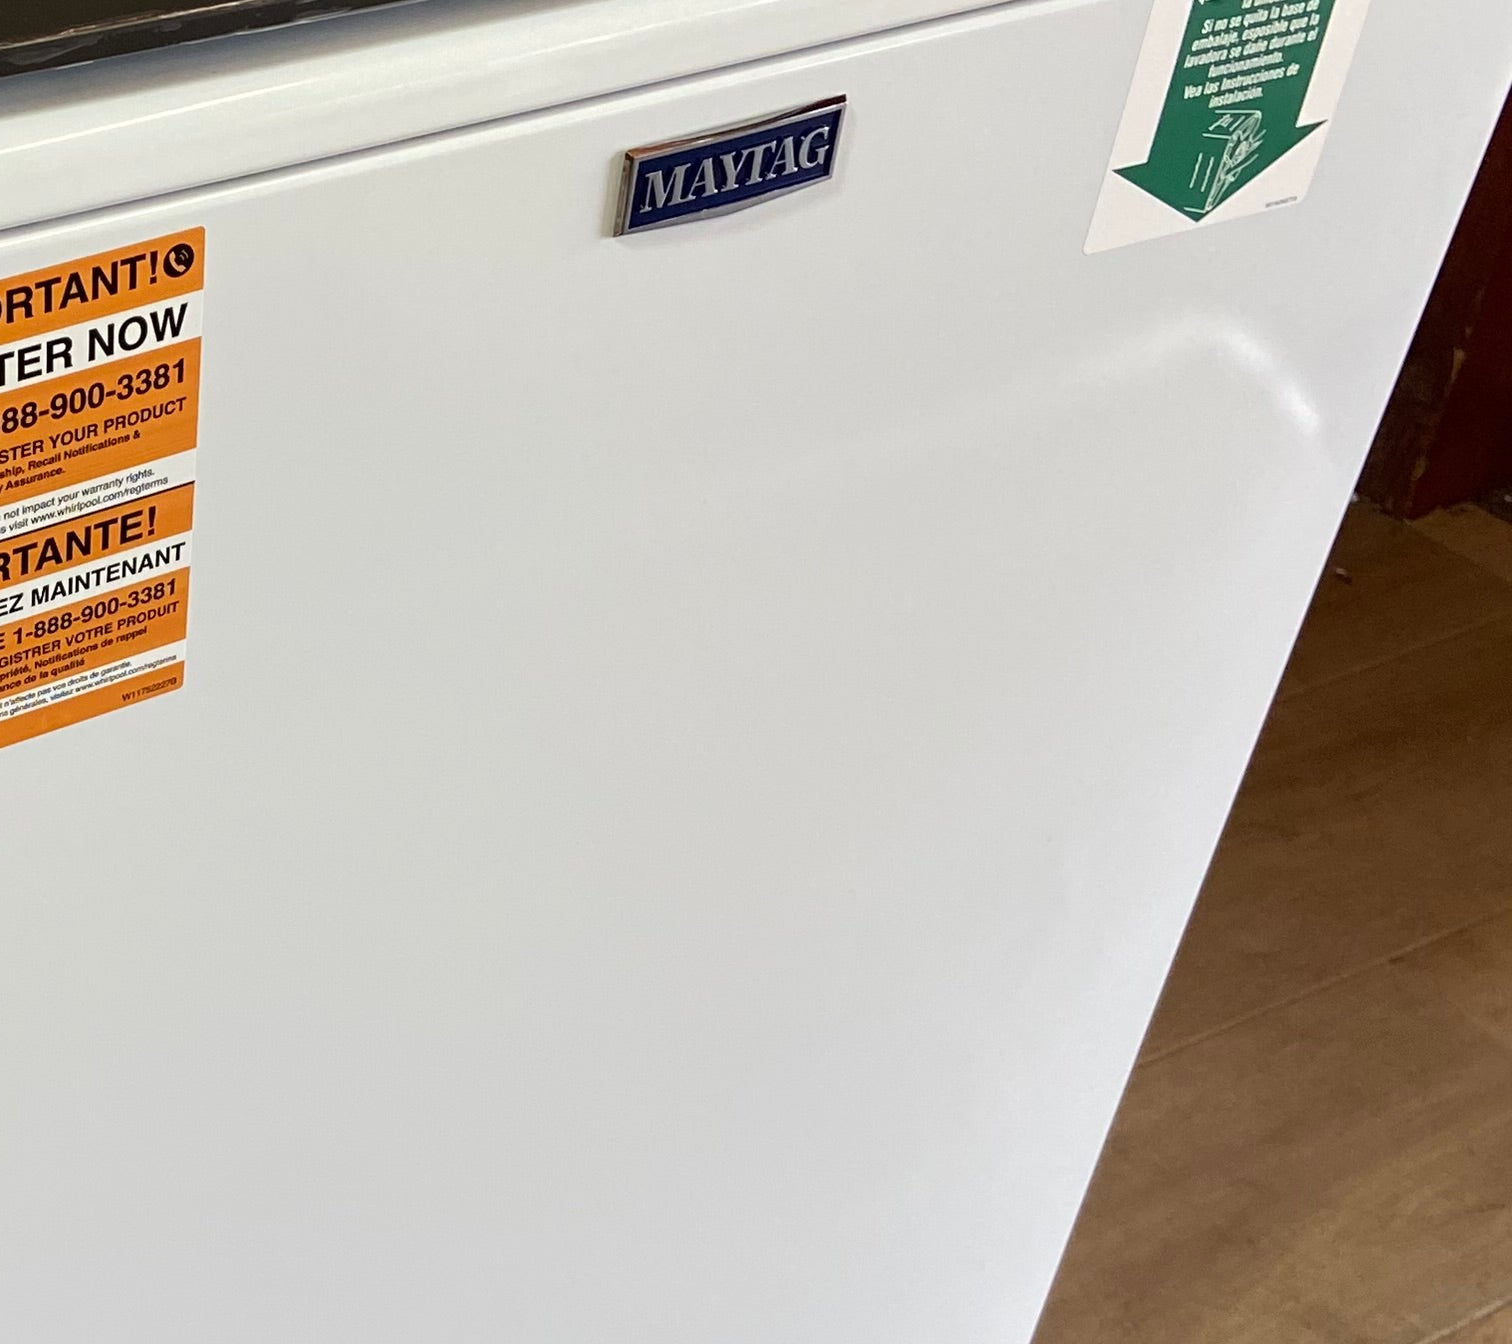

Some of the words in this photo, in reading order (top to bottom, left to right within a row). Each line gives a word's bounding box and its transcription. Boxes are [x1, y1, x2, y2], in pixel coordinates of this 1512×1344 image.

[1184, 86, 1202, 99] Vea
[1204, 81, 1219, 95] las
[1220, 66, 1285, 91] Instrucciones
[639, 126, 830, 213] MAYTAG
[88, 303, 189, 362] NOW
[28, 453, 61, 471] Recall
[64, 433, 130, 461] Notifications
[132, 429, 140, 440] &
[49, 424, 98, 456] YOUR
[104, 397, 187, 436] PRODUCT
[4, 509, 19, 520] not
[22, 500, 55, 515] impact
[57, 493, 80, 508] your
[82, 481, 124, 500] warranty
[127, 468, 155, 485] rights.
[6, 467, 66, 494] Assurance.
[9, 519, 28, 531] visit
[30, 476, 168, 524] www.whirlpool.com/regterms
[31, 542, 186, 607] MAINTENANT
[13, 578, 177, 645] 1-888-900-3381
[65, 623, 113, 644] VOTRE
[117, 602, 180, 629] PRODUIT
